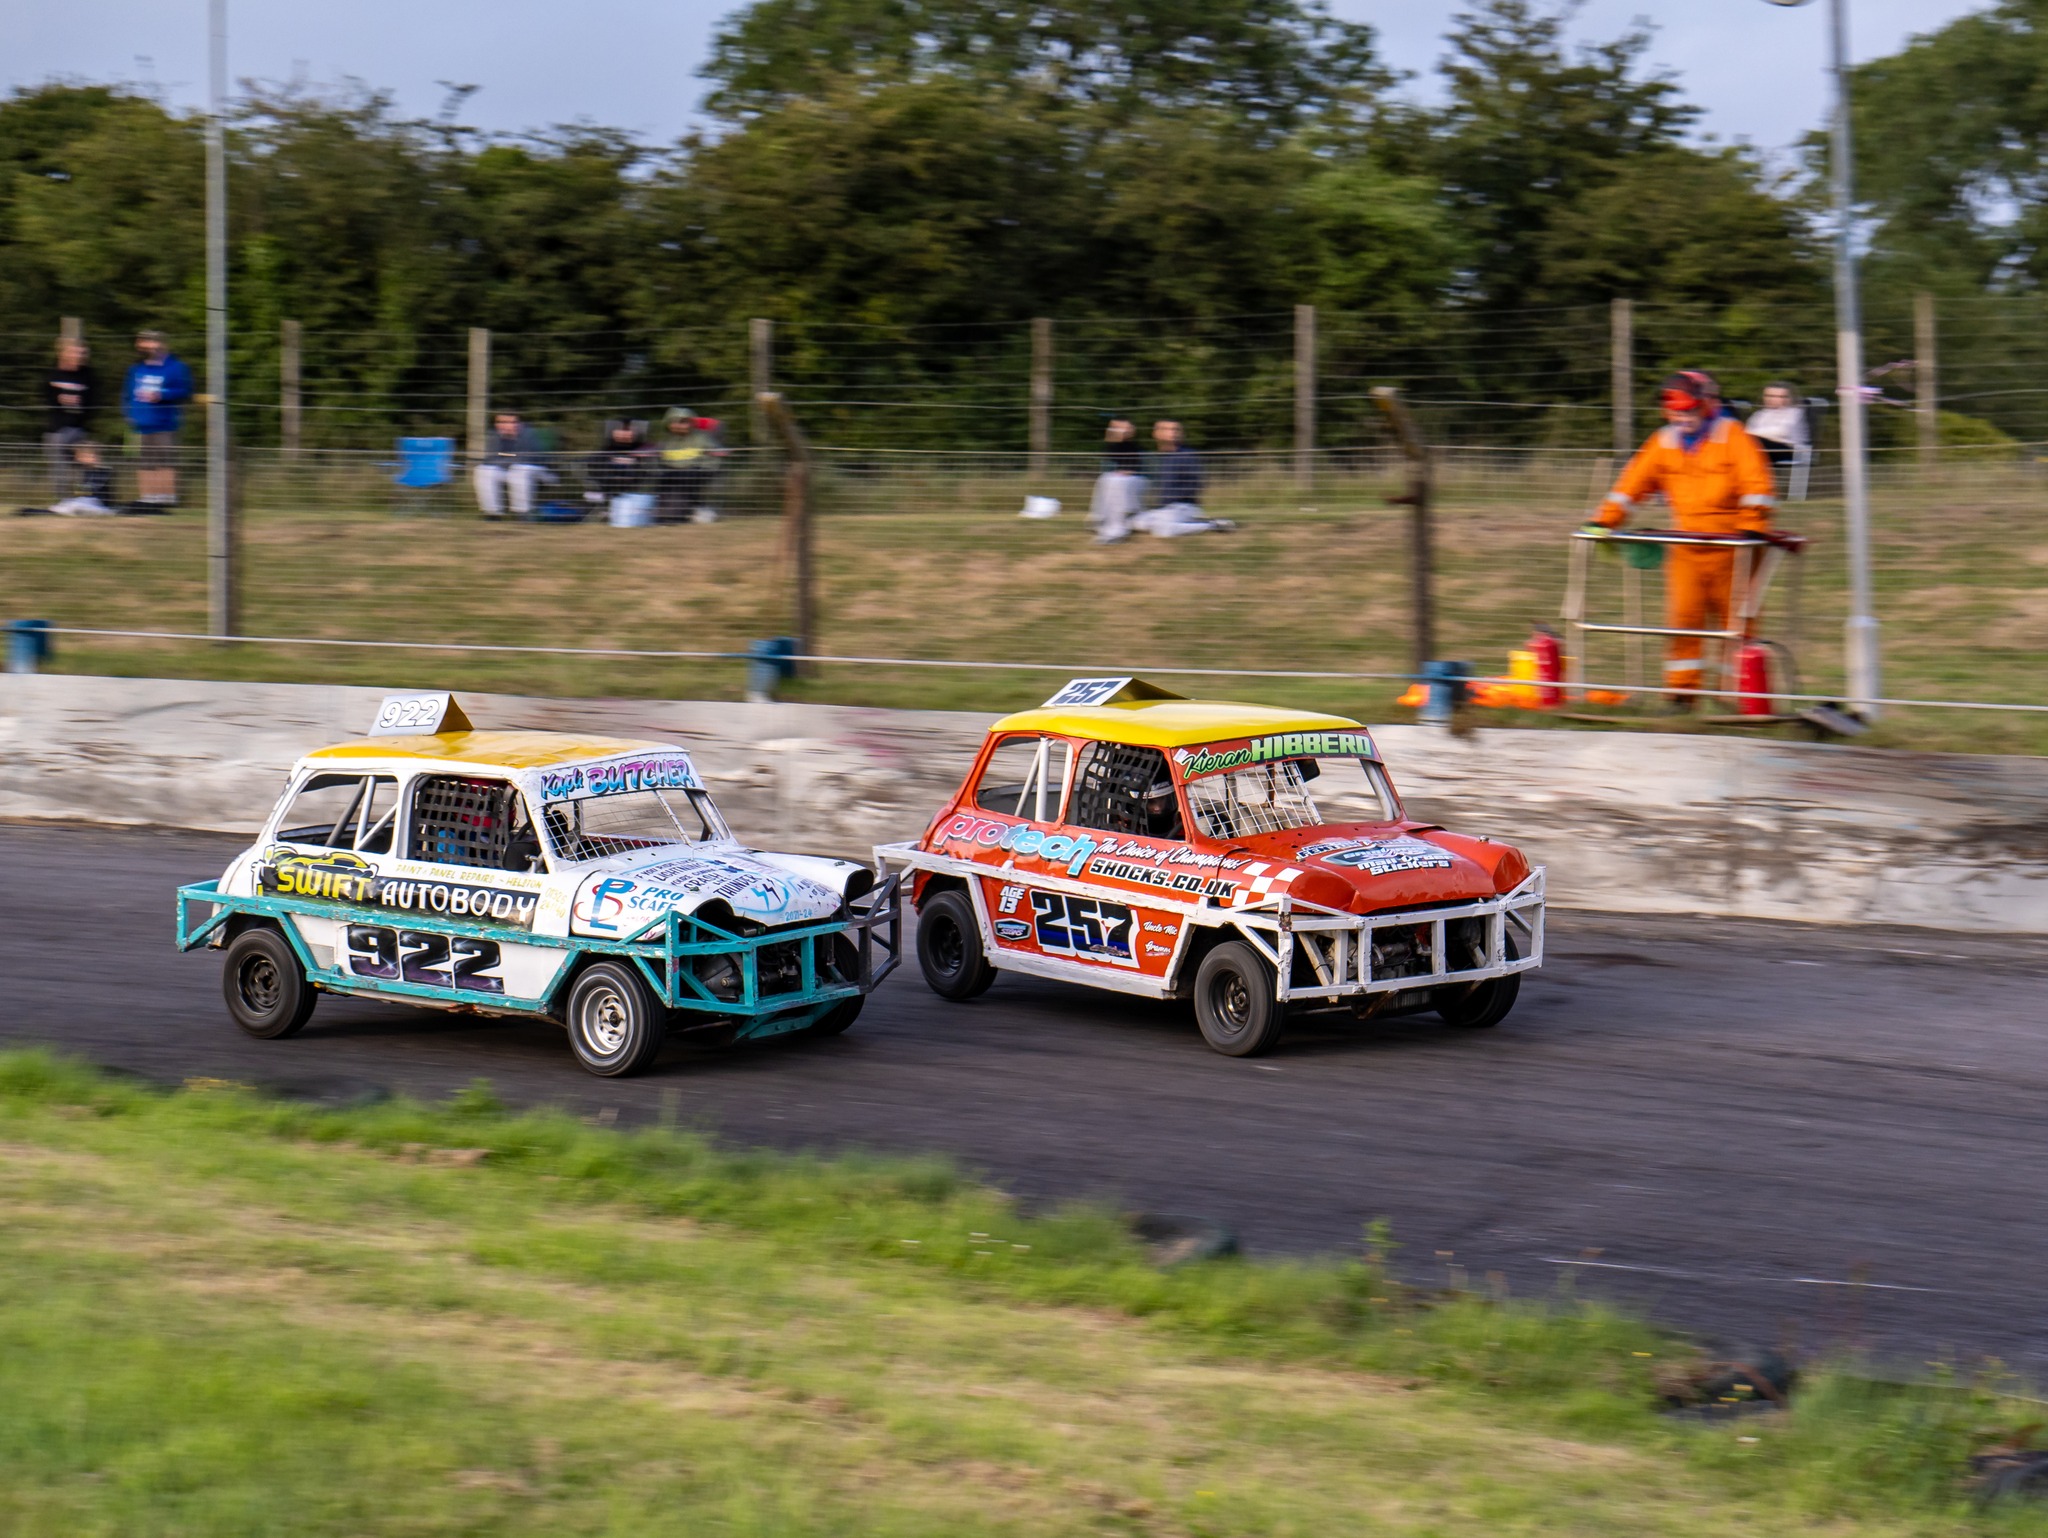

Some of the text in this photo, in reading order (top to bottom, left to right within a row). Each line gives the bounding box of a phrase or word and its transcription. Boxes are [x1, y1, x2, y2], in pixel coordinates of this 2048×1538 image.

[1051, 681, 1122, 704] 257
[379, 699, 440, 728] 922
[1182, 733, 1373, 779] Kieran HIBBERD
[586, 759, 695, 795] BUTCHER
[933, 814, 1097, 877] protech
[1094, 837, 1251, 869] The Choice of Champions!
[429, 867, 456, 880] PANEL
[459, 871, 495, 884] REPAIRS
[1089, 857, 1242, 898] SHOCKS.CO.UK
[276, 866, 536, 922] SWIFT AUTOBODY
[627, 896, 678, 912] SCAFF
[641, 886, 684, 901] PRO
[998, 896, 1019, 914] 13
[999, 886, 1026, 900] AGE
[1030, 890, 1136, 962] 257
[347, 923, 505, 994] 922
